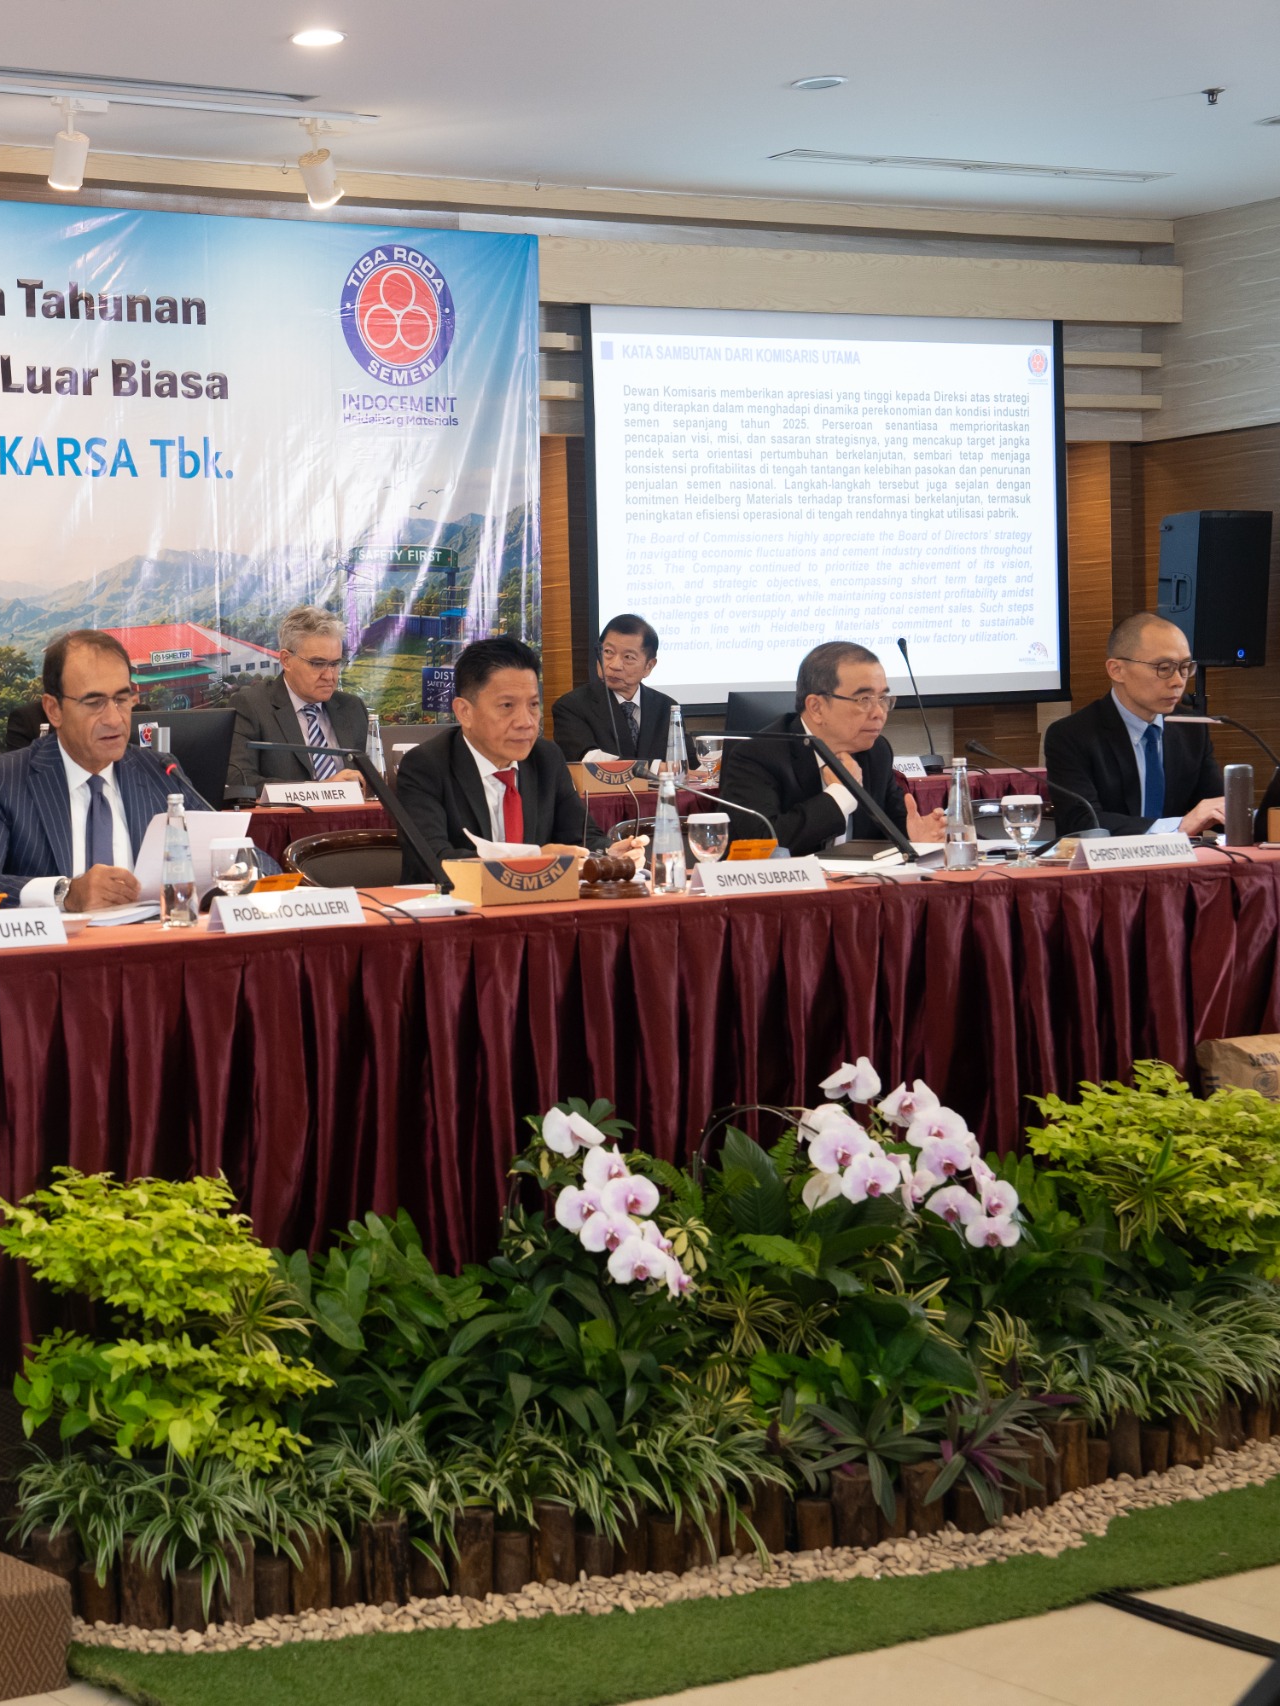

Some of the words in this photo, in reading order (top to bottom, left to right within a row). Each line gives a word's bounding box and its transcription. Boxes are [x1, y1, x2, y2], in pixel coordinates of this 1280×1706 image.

[346, 249, 388, 289] TIGA
[393, 246, 445, 295] RODA
[16, 278, 208, 326] Tahunan
[622, 344, 653, 359] KATA
[656, 345, 721, 360] SAMBUTAN
[724, 347, 752, 361] DARI
[756, 348, 818, 363] KOMISARIS
[822, 350, 860, 364] UTAMA
[0, 354, 100, 397] Luar
[111, 358, 230, 400] Biasa
[367, 358, 437, 385] SEMEN
[342, 393, 457, 413] INDOCEMENT
[623, 384, 659, 396] Dewan
[663, 385, 716, 397] Komisaris
[720, 387, 783, 398] memberikan
[787, 388, 832, 402] apresiasi
[836, 391, 860, 402] yang
[863, 389, 891, 403] tinggi
[895, 390, 930, 403] kepada
[934, 390, 967, 402] Direksi
[970, 392, 990, 402] atas
[993, 392, 1029, 404] strategi
[406, 413, 459, 427] Materials
[624, 418, 659, 427] semen
[672, 417, 727, 431] sepanjang
[740, 418, 769, 428] tahun
[782, 418, 808, 429] 2025.
[822, 418, 872, 430] Perseroan
[885, 419, 937, 430] senantiasa
[950, 420, 1029, 433] memprioritaskan
[150, 435, 235, 479] Tbk.
[625, 509, 692, 523] peningkatan
[695, 508, 739, 520] efisiensi
[743, 508, 802, 522] operasional
[806, 508, 814, 519] di
[817, 508, 852, 521] tengah
[856, 508, 907, 521] rendahnya
[910, 507, 944, 520] tingkat
[946, 507, 984, 518] utilisasi
[986, 507, 1018, 520] pabrik.
[358, 549, 402, 561] SAFETY
[407, 549, 442, 562] FIRST
[284, 790, 318, 804] HASAN
[320, 788, 347, 802] IMER
[1089, 847, 1133, 861] CHRISTIAN
[500, 862, 564, 892] SEMEN
[716, 873, 757, 887] SIMON
[757, 870, 810, 885] SUBRATA
[294, 900, 350, 917] CALLIERI
